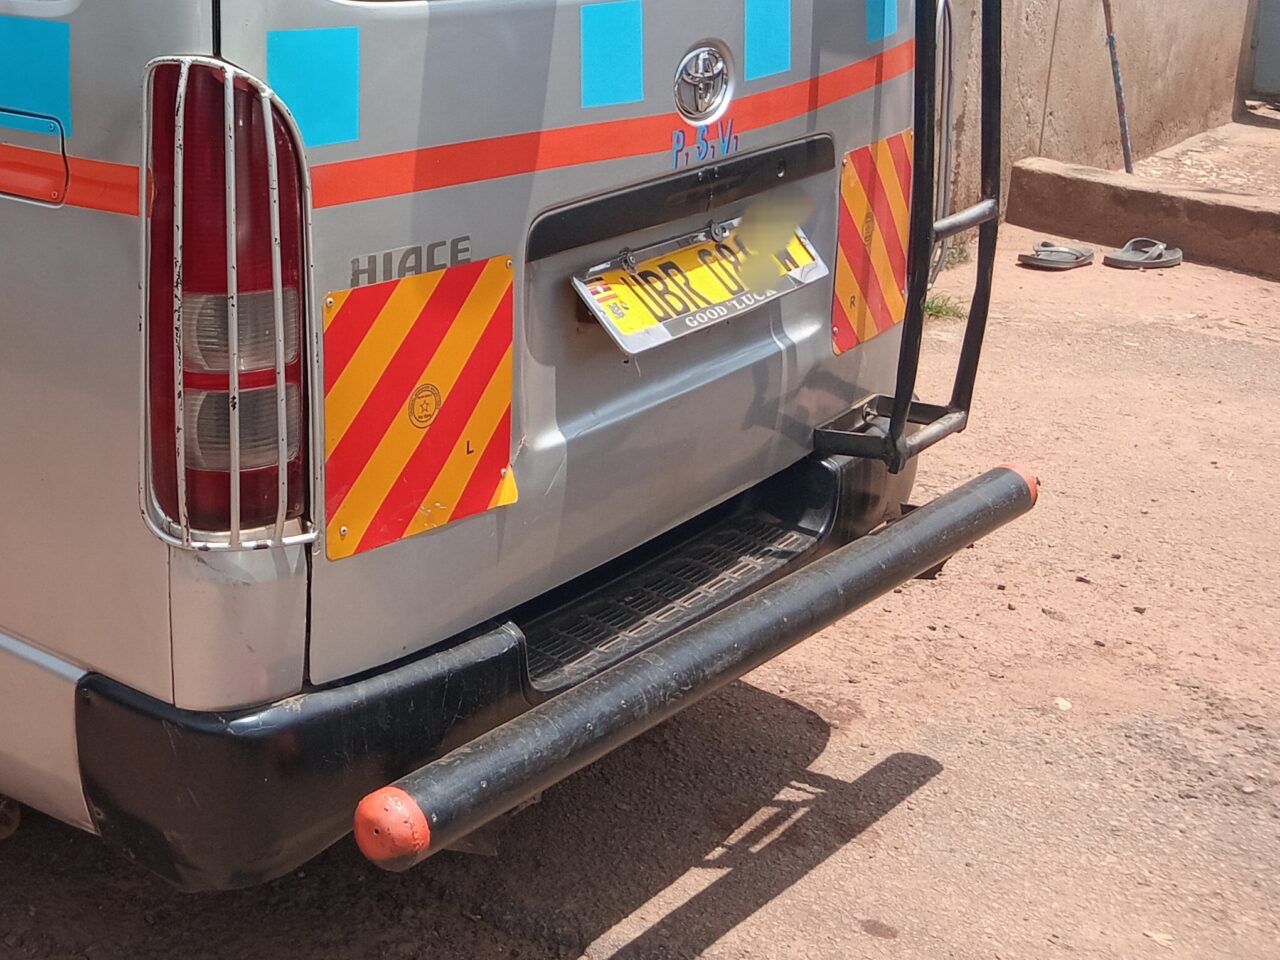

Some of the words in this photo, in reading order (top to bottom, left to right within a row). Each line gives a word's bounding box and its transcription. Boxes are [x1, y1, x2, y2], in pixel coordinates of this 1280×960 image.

[350, 235, 471, 288] HIACE
[685, 304, 728, 327] GOOD
[466, 440, 474, 455] L
